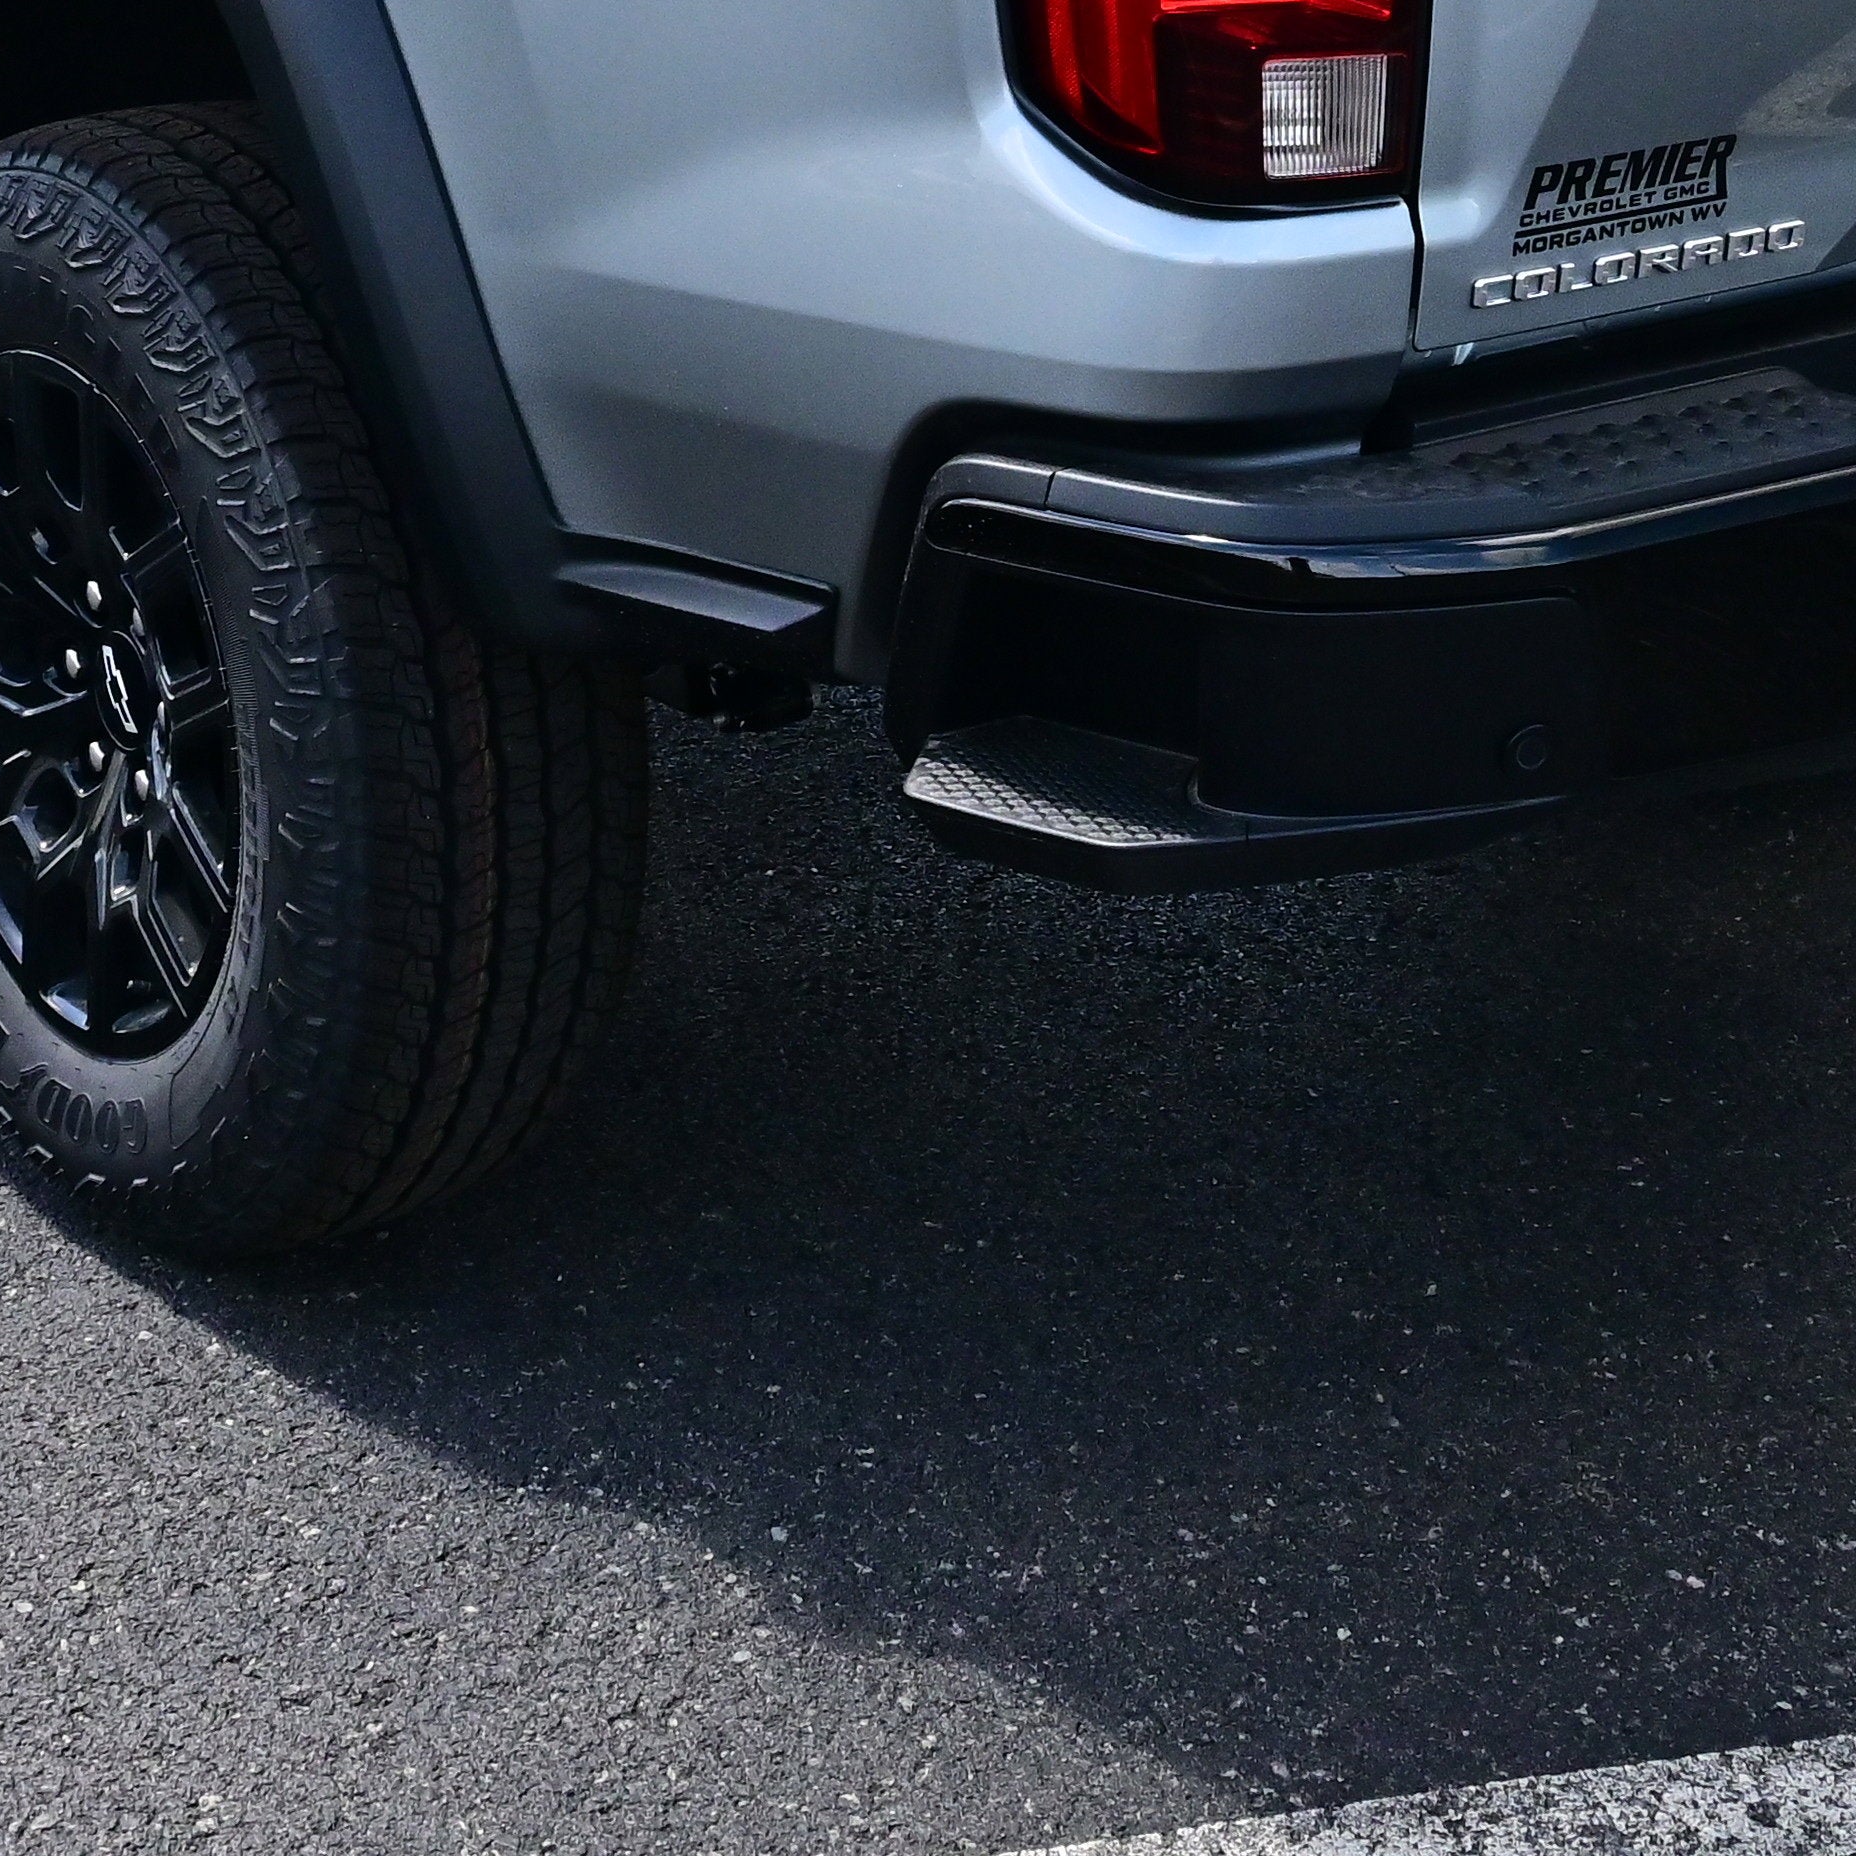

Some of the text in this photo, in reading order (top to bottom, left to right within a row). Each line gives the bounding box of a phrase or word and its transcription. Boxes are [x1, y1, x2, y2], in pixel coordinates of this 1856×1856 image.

[1519, 181, 1711, 228] CHEVROLET GMC
[1522, 133, 1738, 211] PREMIER
[1511, 201, 1728, 257] MORGANTOWN WV
[1471, 219, 1806, 309] COLORADO
